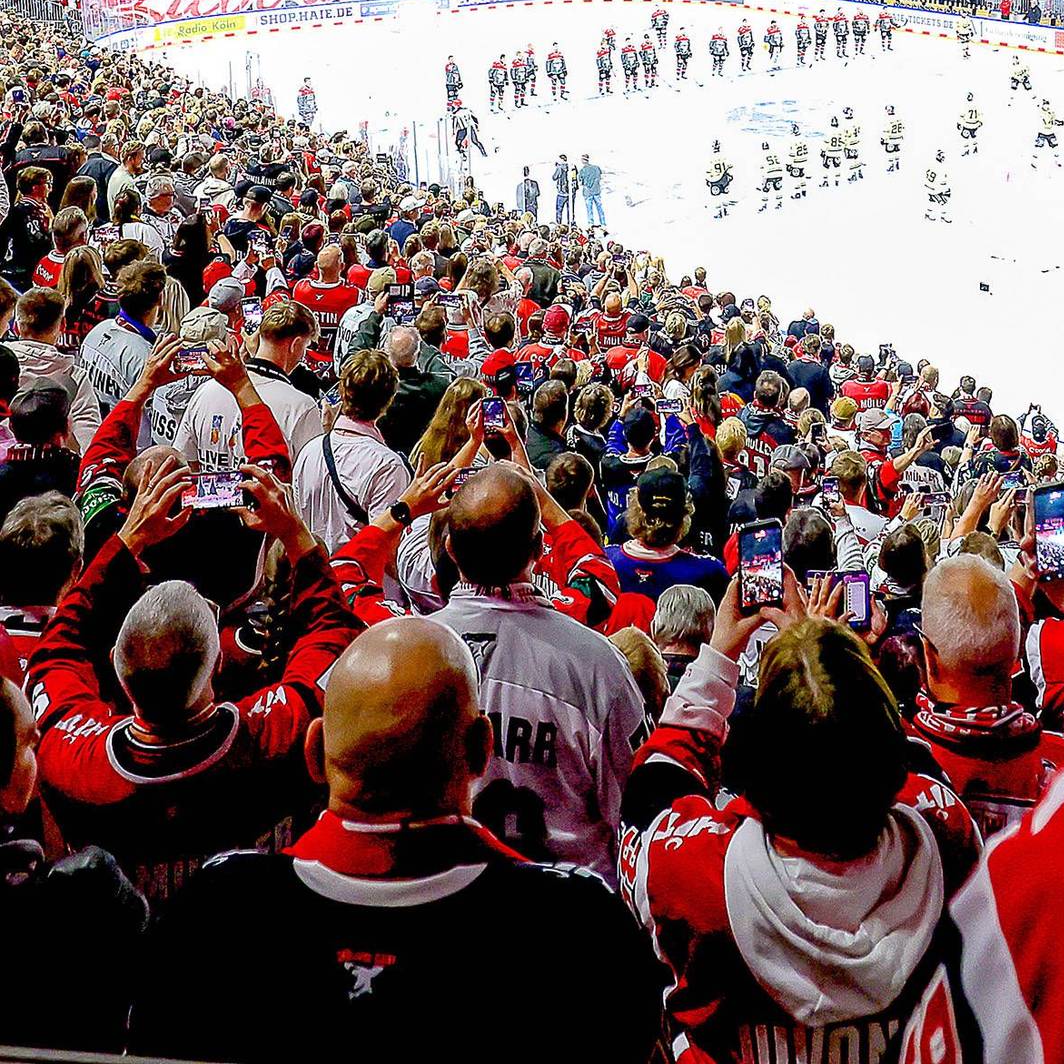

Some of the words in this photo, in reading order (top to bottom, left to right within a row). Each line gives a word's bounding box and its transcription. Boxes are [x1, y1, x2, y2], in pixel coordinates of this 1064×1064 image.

[260, 7, 353, 25] SHOP.HAIE.DE
[178, 23, 208, 37] Radio
[211, 19, 236, 31] Köln
